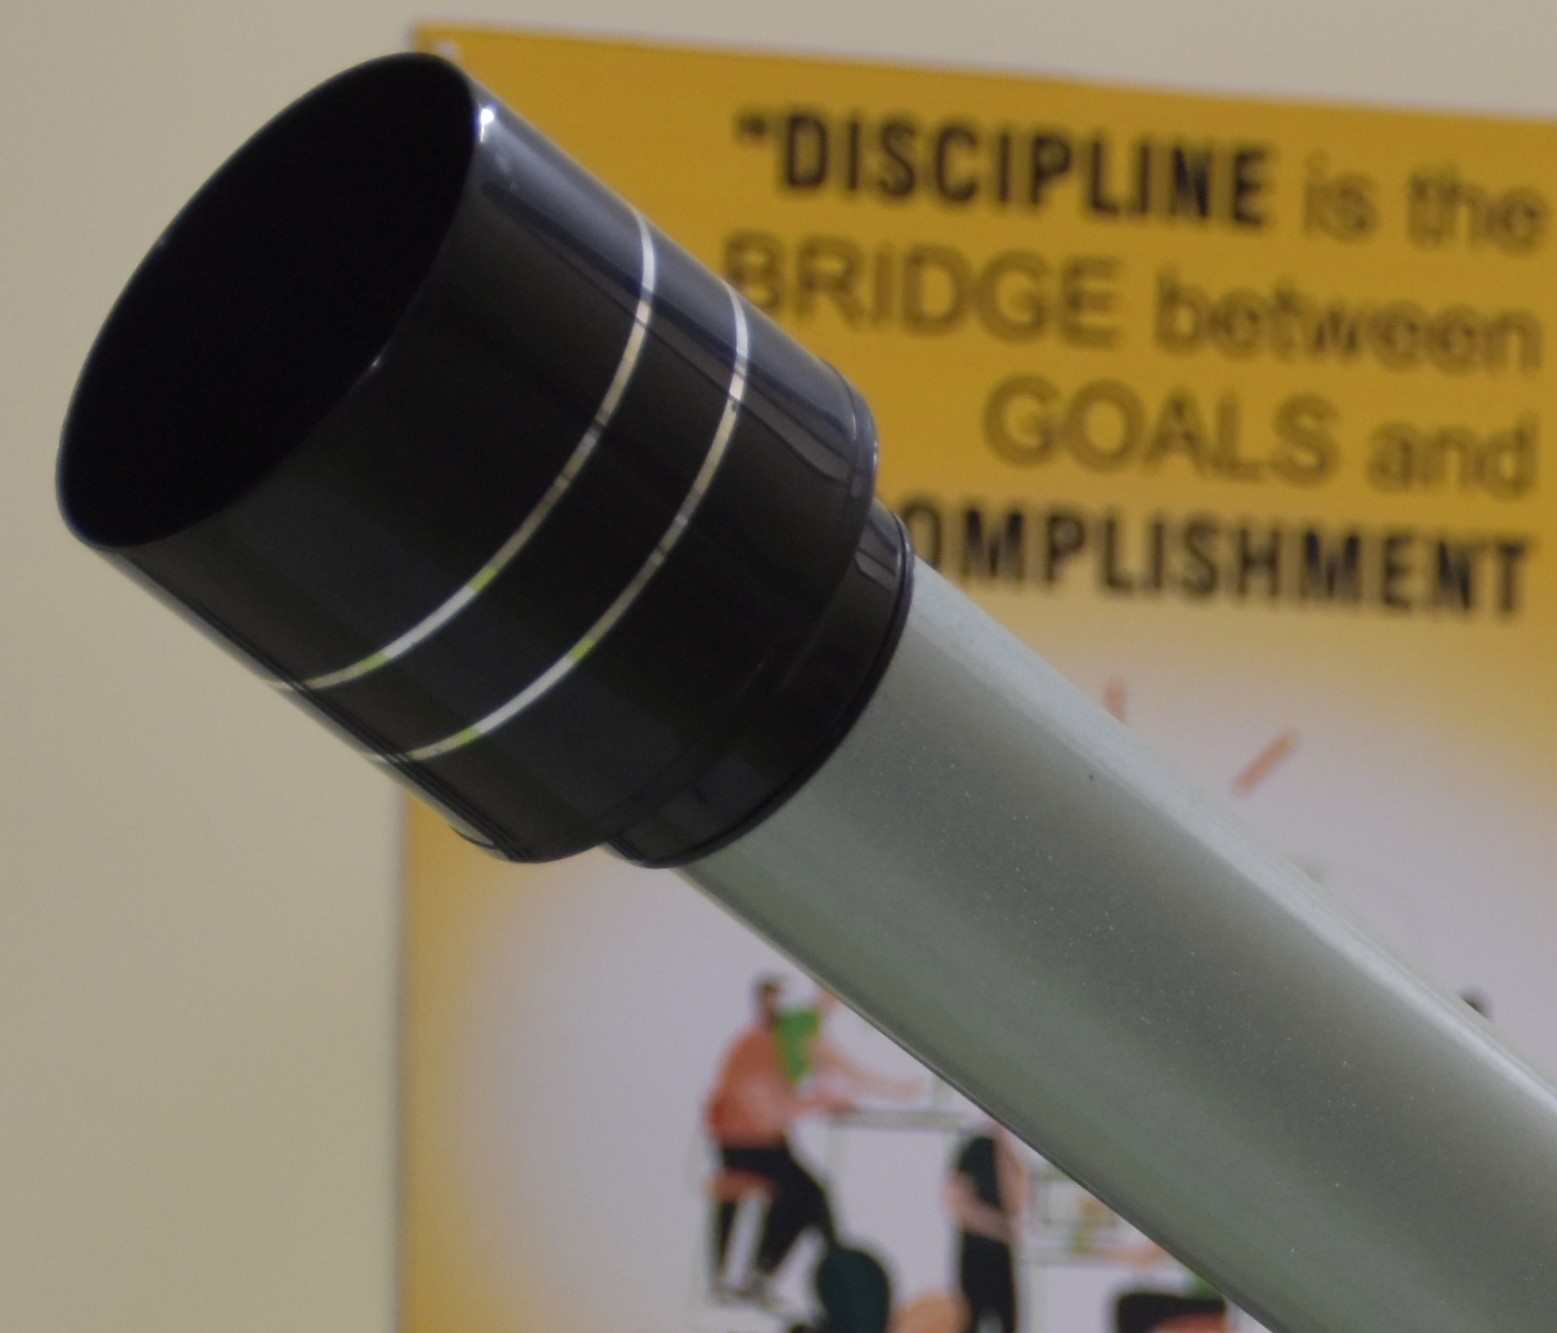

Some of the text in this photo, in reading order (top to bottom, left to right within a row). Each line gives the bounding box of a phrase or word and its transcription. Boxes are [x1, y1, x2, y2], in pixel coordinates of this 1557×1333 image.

[1304, 150, 1381, 243] is
[1407, 161, 1549, 256] the
[724, 231, 1543, 374] BRIDGE between
[982, 373, 1540, 500] GOALS and
[900, 498, 1529, 617] OMPLISHMENT
